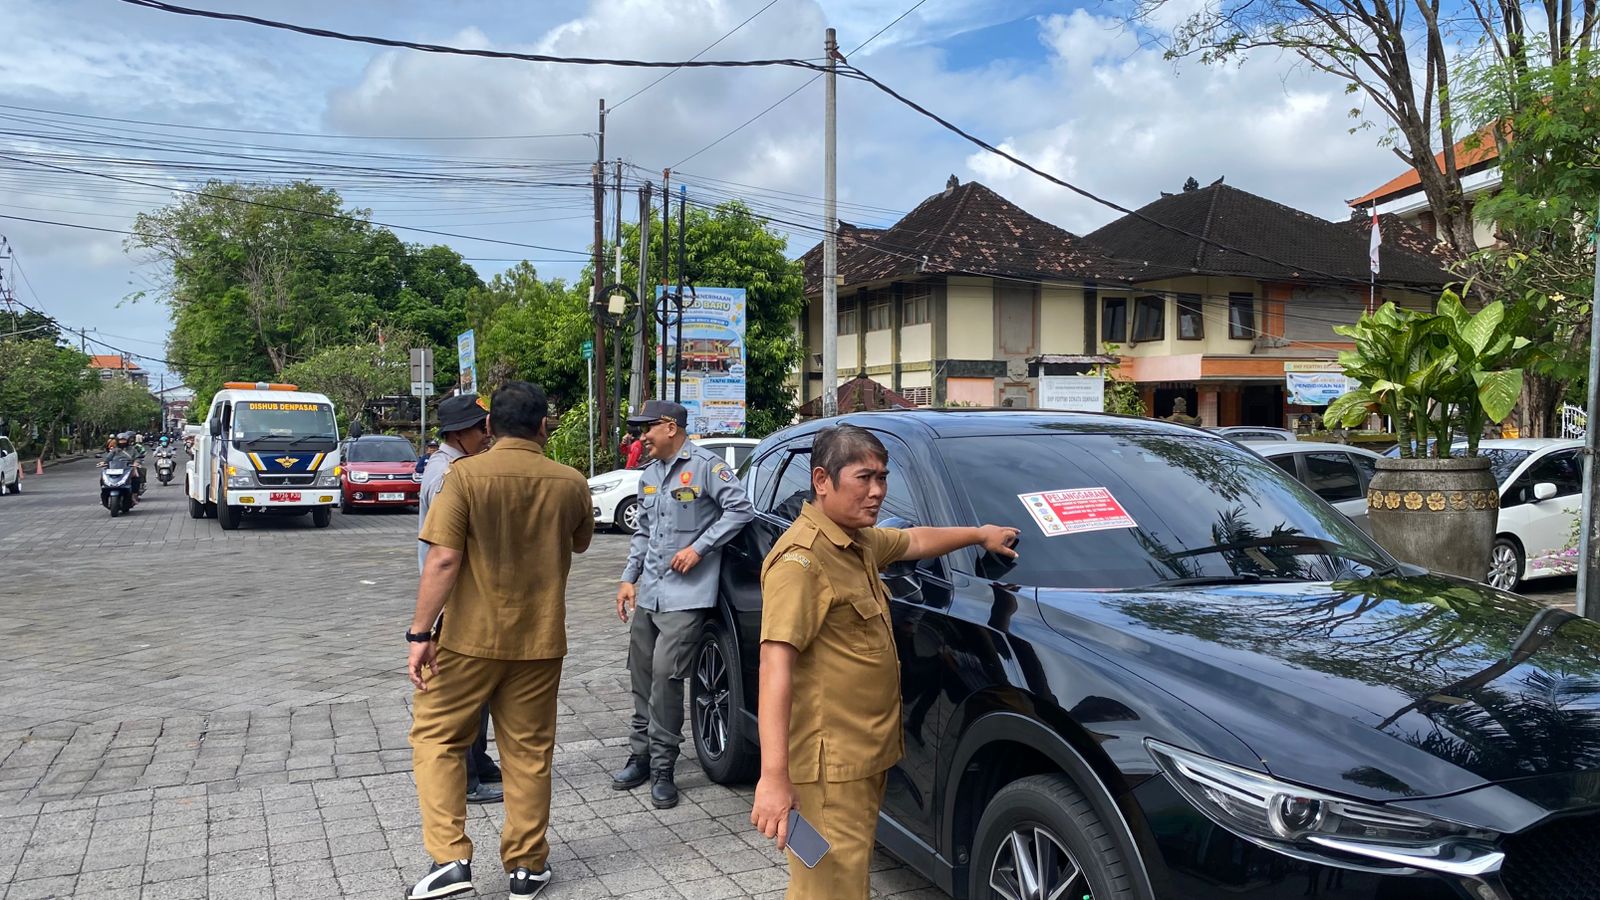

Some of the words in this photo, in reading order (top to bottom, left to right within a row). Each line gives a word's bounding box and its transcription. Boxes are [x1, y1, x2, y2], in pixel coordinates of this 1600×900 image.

[703, 300, 731, 312] BARU
[249, 402, 278, 410] DISHUB
[280, 403, 318, 411] DENPASAR
[1047, 490, 1106, 502] PELANGGARAN
